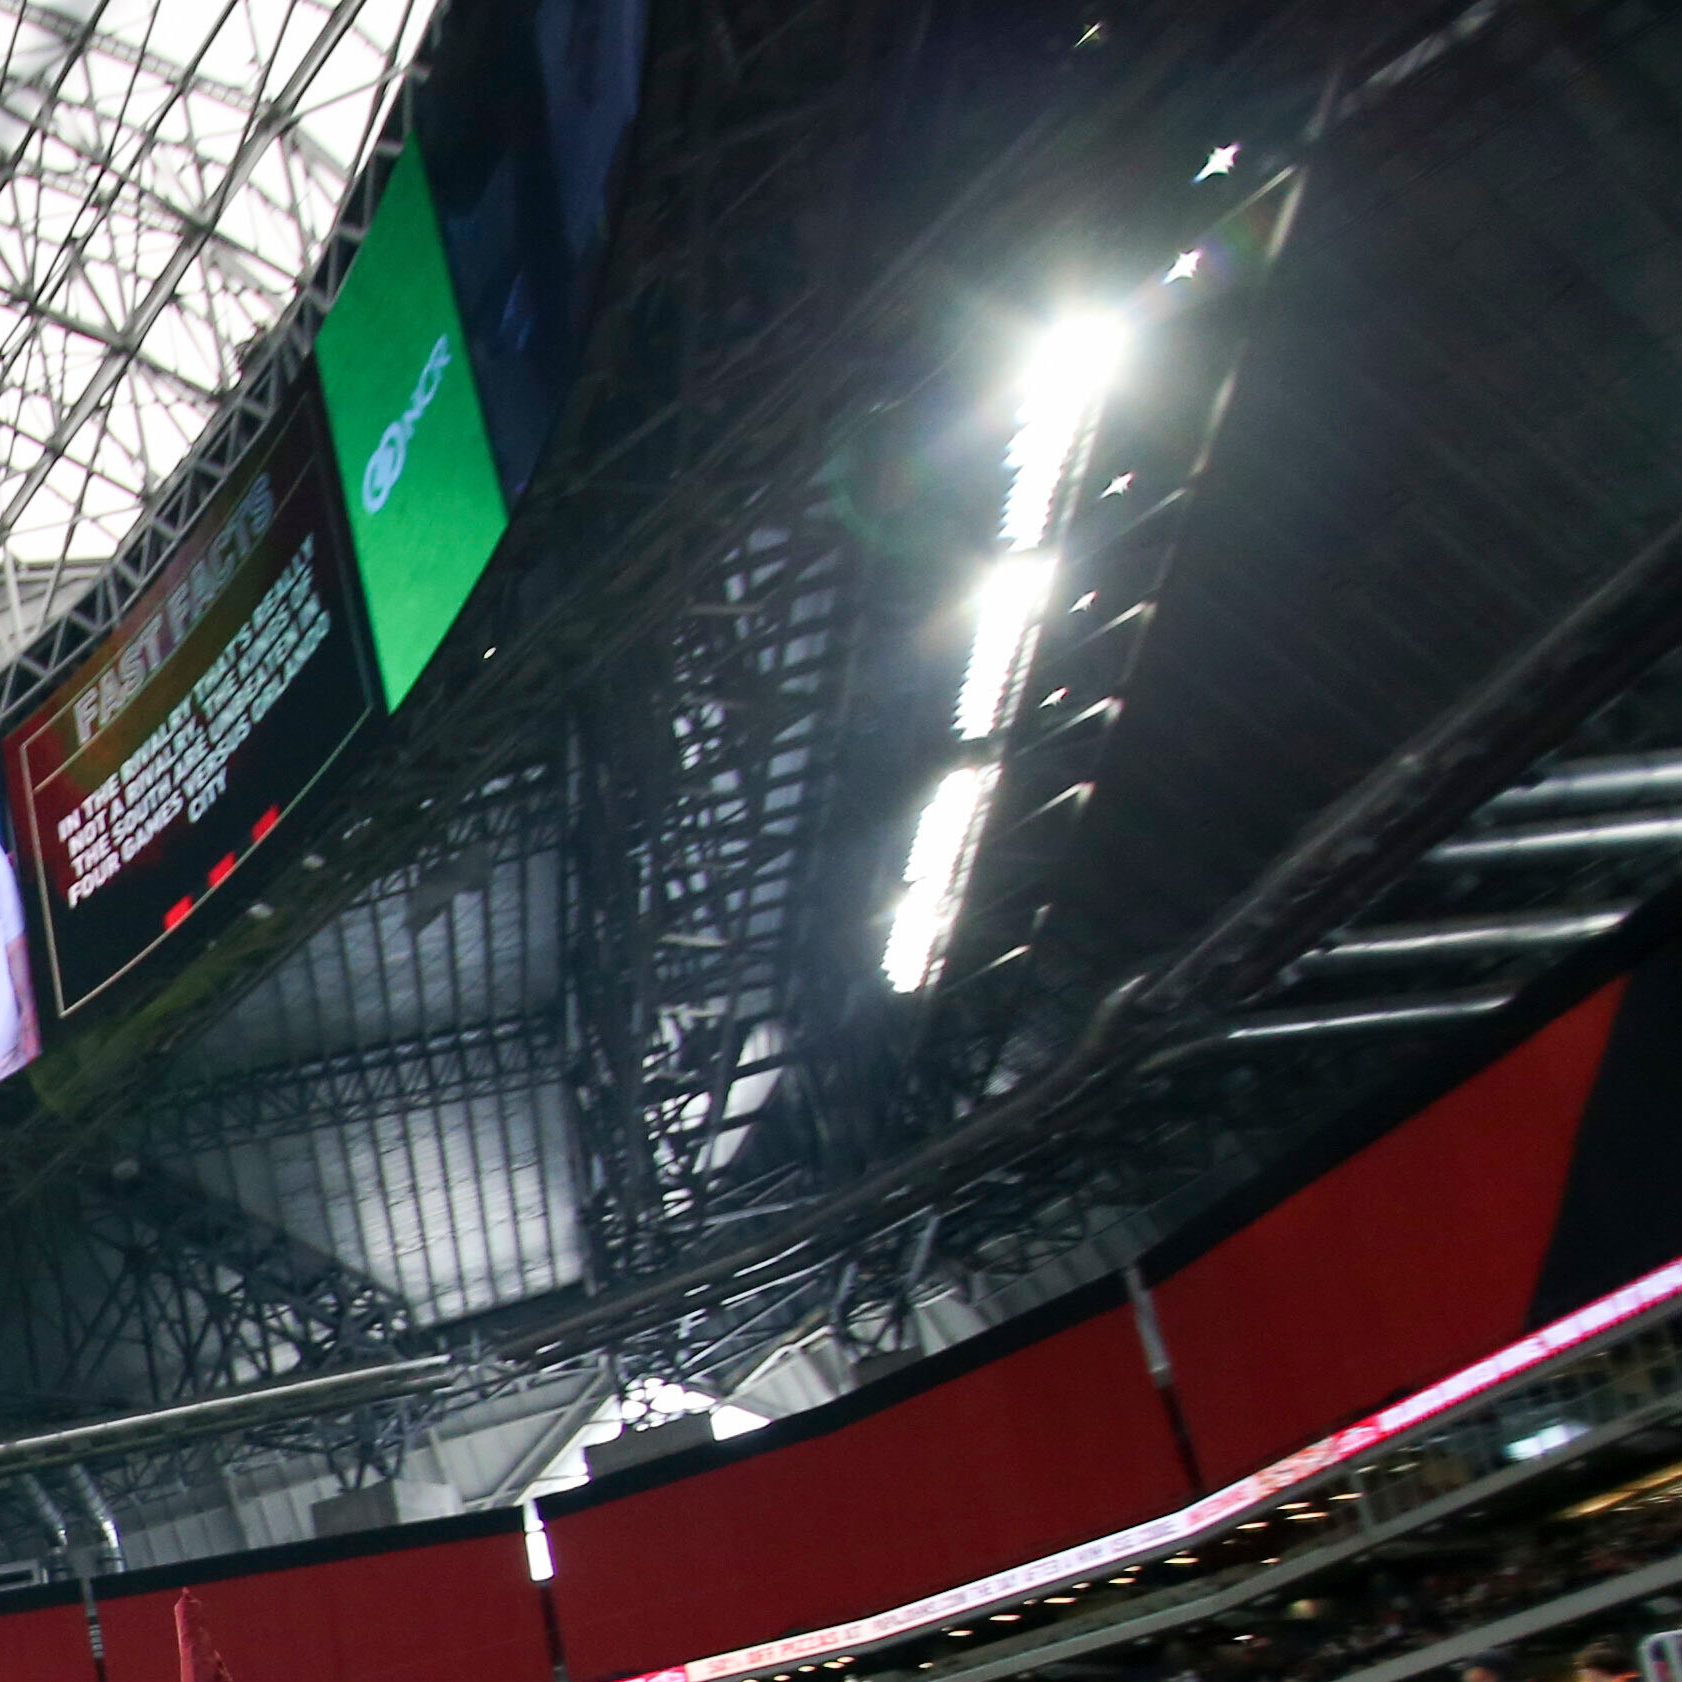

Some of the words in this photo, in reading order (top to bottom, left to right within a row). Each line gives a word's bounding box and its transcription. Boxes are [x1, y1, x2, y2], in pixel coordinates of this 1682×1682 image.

[72, 613, 163, 745] FAST
[68, 808, 107, 858] NOT
[71, 832, 112, 877] THE
[67, 851, 121, 909] FOUR
